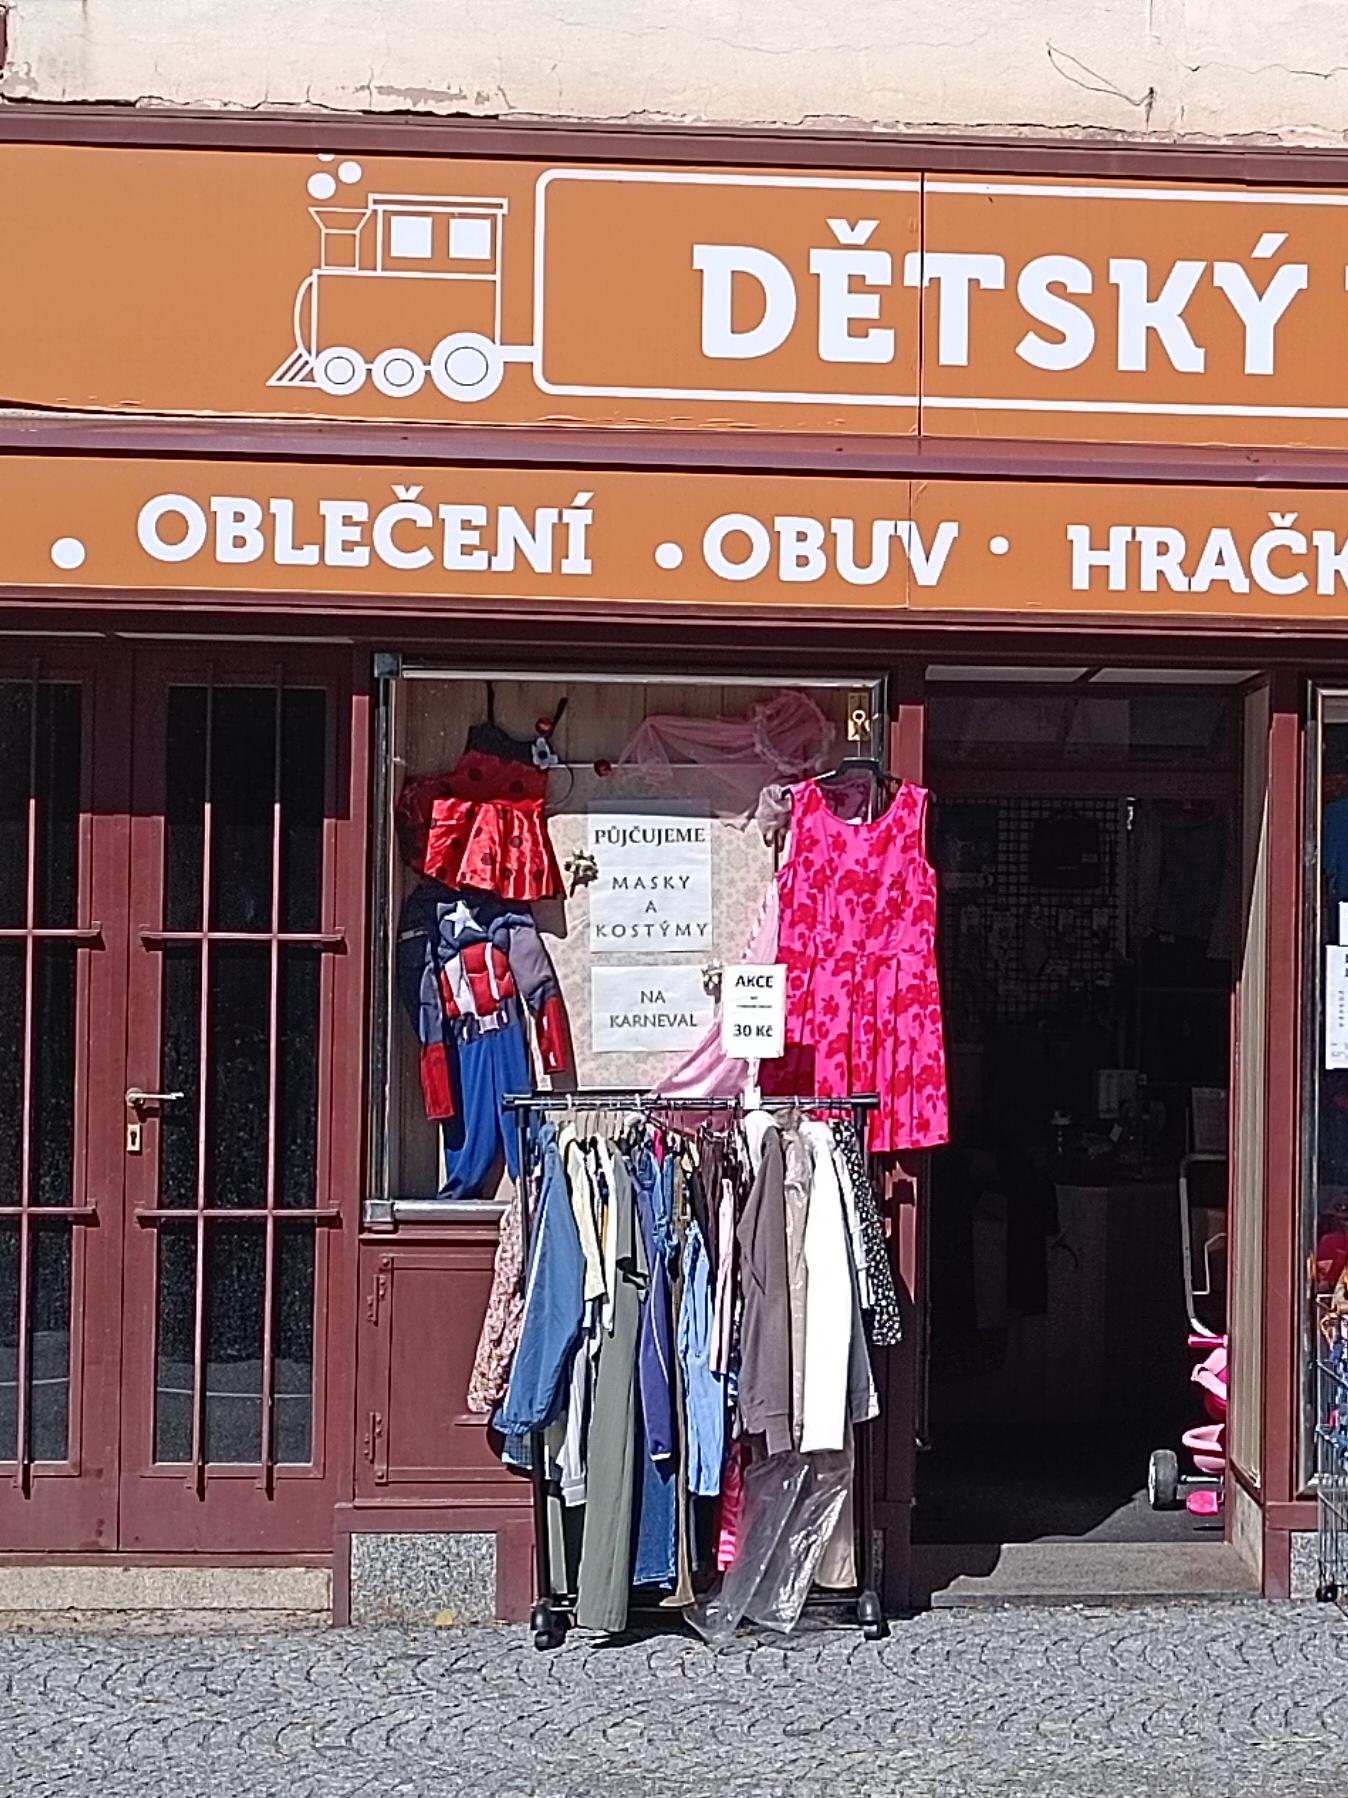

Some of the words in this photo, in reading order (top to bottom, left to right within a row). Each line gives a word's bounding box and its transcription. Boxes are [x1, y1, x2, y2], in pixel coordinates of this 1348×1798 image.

[693, 218, 1308, 375] DĚTSKÝ
[137, 485, 594, 576] OBLEČENÍ
[703, 513, 960, 586] OBUV
[594, 826, 705, 847] PŮJČUJEME
[612, 875, 690, 890] MASKY
[645, 900, 657, 914] A
[596, 920, 709, 938] KOSTÝMY
[735, 975, 774, 988] AKCE
[641, 990, 666, 1003] NA
[610, 1014, 698, 1028] KARNEVAL
[733, 1023, 752, 1037] 30
[756, 1024, 774, 1037] Kč
